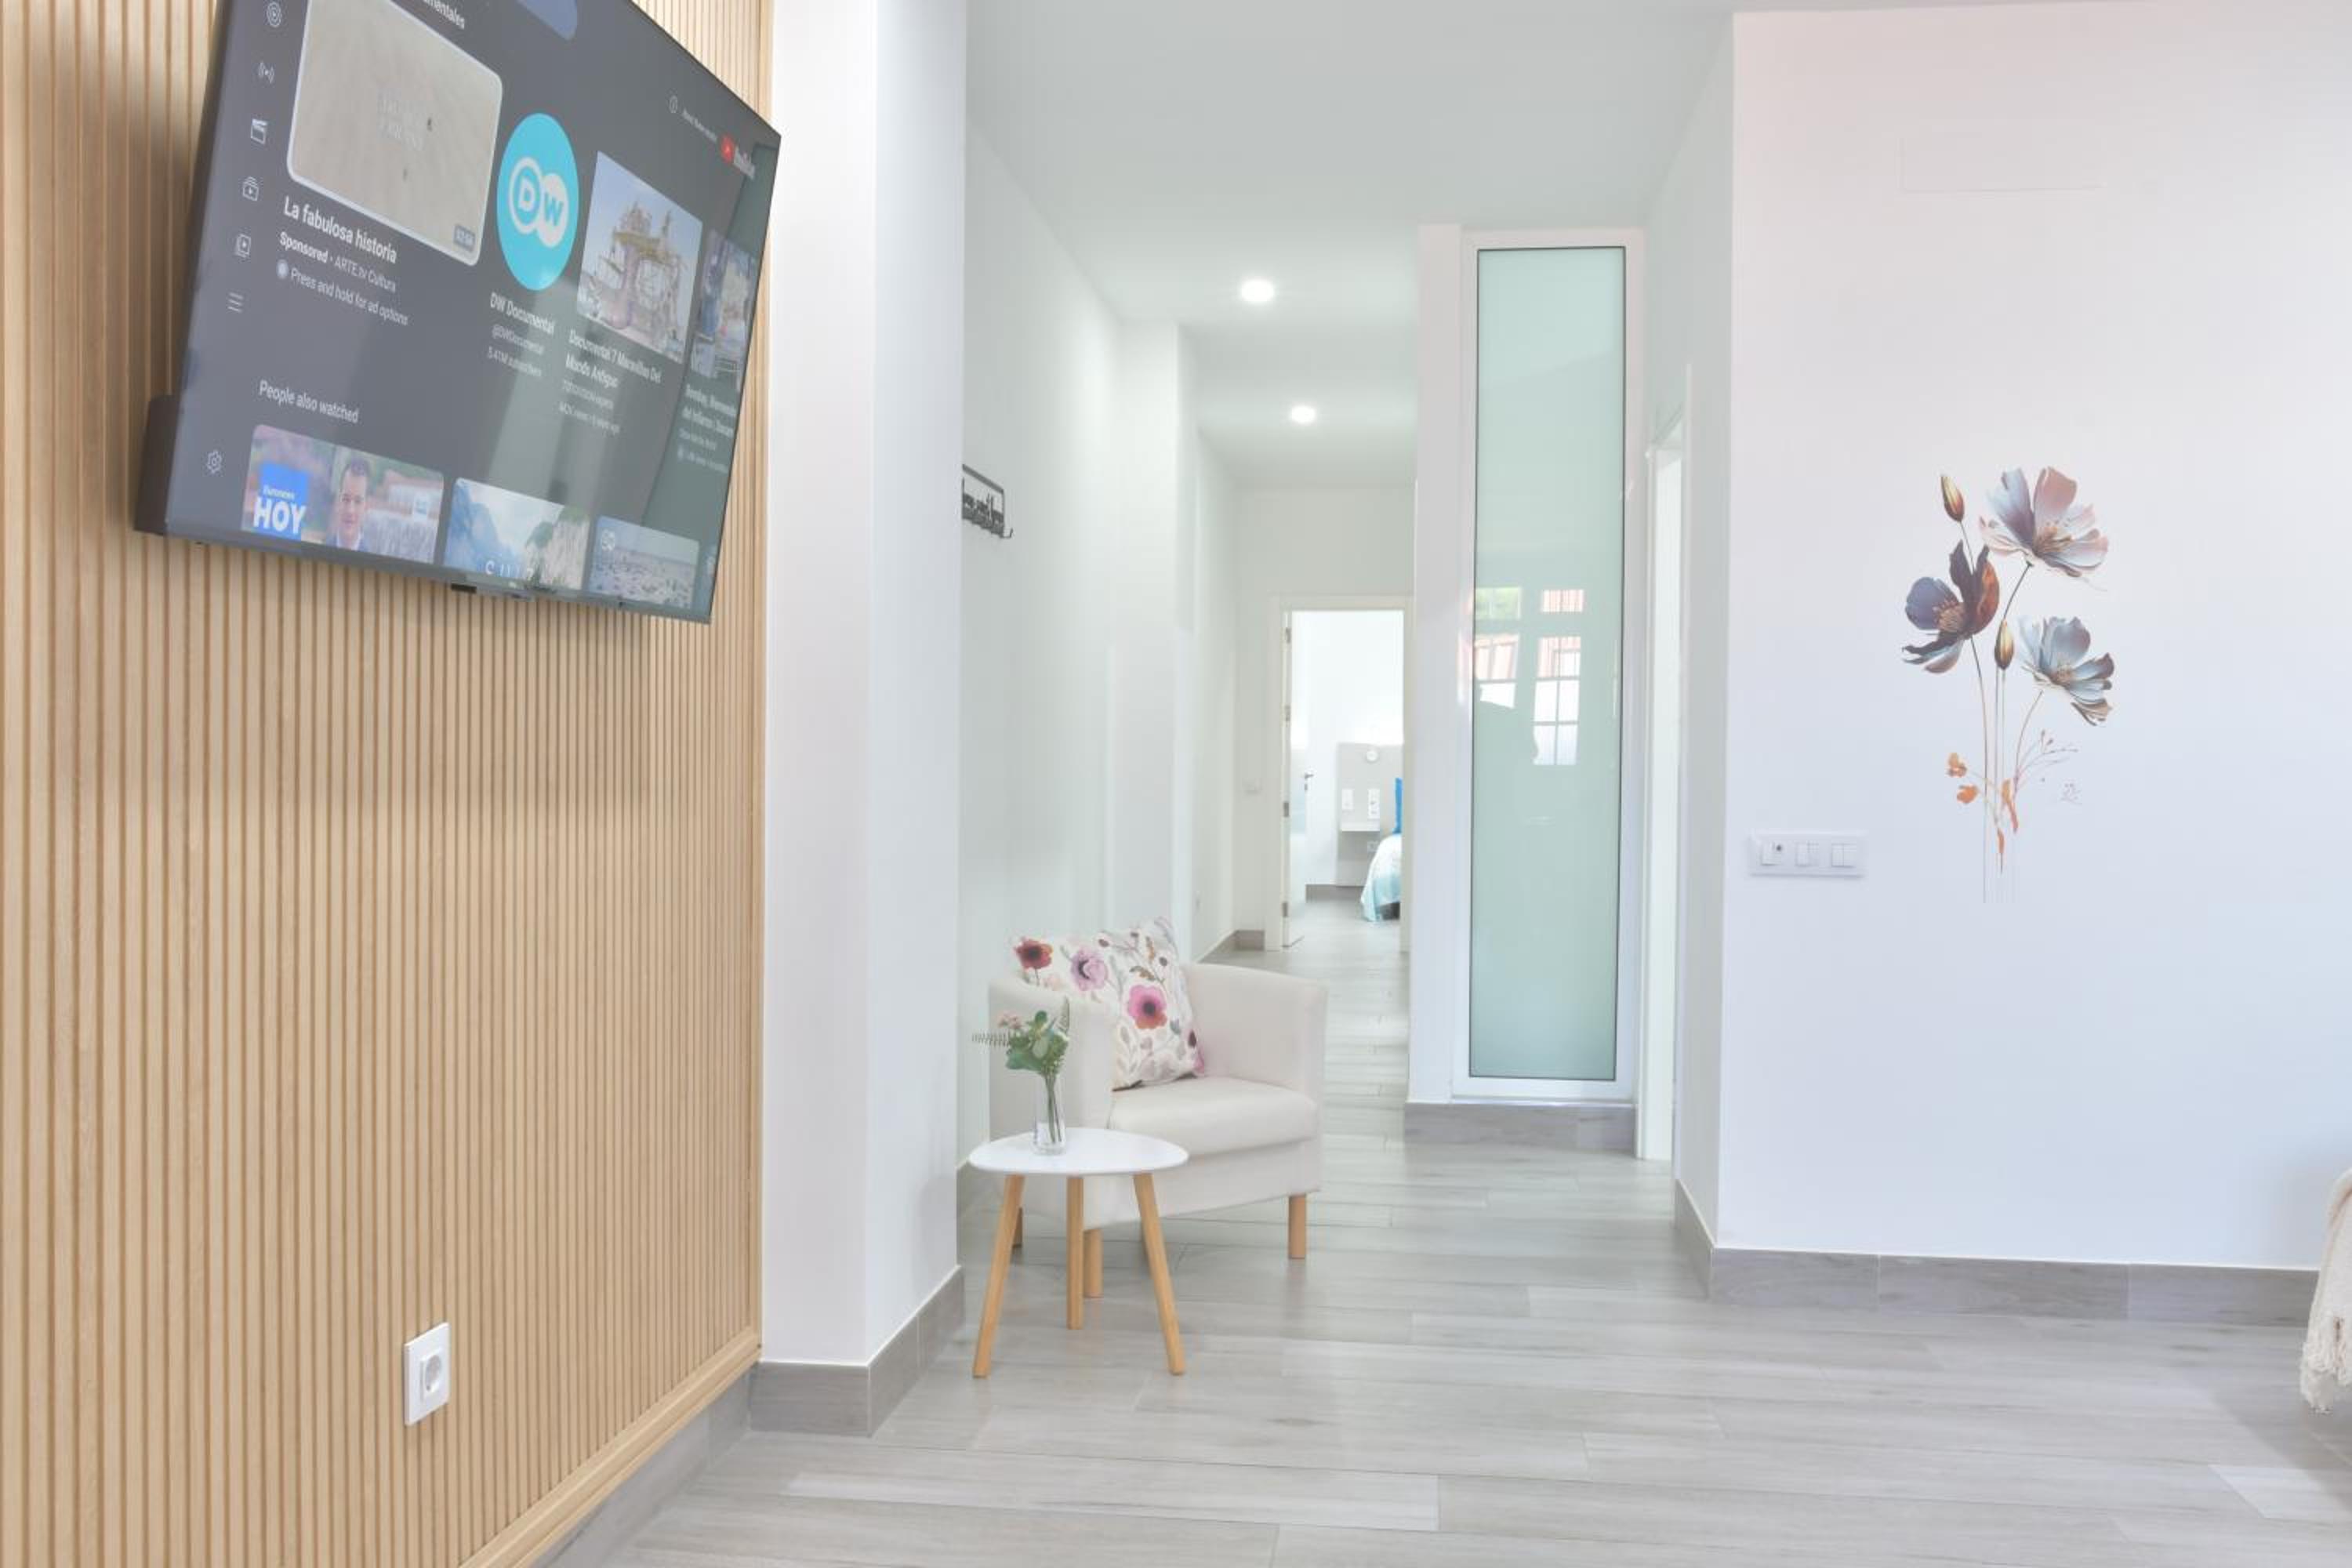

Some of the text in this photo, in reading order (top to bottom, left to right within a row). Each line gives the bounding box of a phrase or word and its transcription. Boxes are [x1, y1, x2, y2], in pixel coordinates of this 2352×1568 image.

[283, 195, 397, 263] La fabulosa historia
[279, 231, 328, 263] Sponsored
[368, 270, 396, 293] Cultura
[291, 267, 408, 325] Press and hold for ad options
[490, 292, 555, 335] DW Documental
[260, 379, 359, 424] People also watched
[253, 496, 307, 535] HOY
